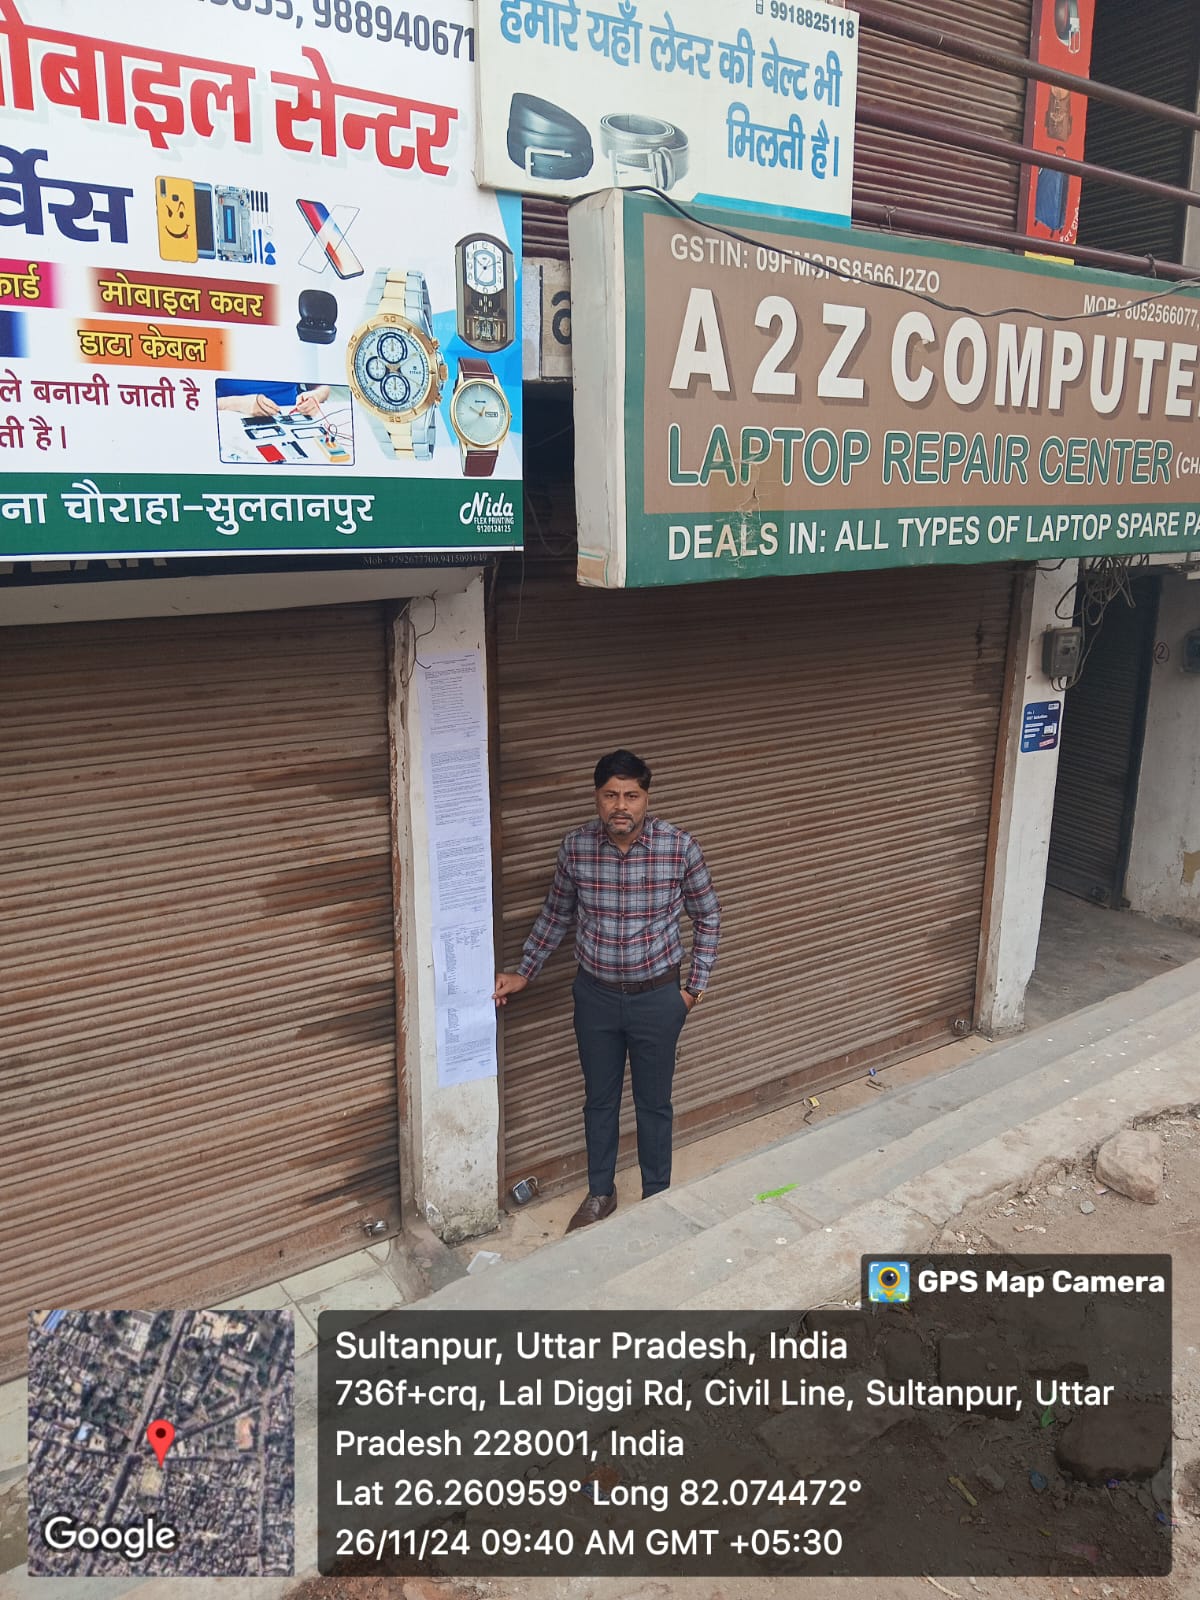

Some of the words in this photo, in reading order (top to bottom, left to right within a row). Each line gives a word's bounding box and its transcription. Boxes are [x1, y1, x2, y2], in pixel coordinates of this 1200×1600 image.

[770, 0, 855, 38] 9918825118
[650, 11, 713, 79] लेदर
[719, 28, 755, 88] की
[761, 38, 809, 100] बेल्ट
[814, 50, 843, 107] भी
[270, 45, 458, 176] सेन्टर
[726, 102, 805, 171] मिलती
[670, 233, 748, 268] GSTIN:
[99, 271, 201, 316] मोबाइल
[209, 288, 265, 318] कवर
[1083, 294, 1120, 318] MOB:
[78, 330, 132, 357] डाटा
[140, 324, 207, 362] केबल
[891, 311, 1200, 417] COMPUTE
[31, 373, 109, 406] बनायी
[118, 377, 175, 408] जाती
[180, 377, 200, 410] है
[668, 423, 871, 487] LAPTOP
[882, 430, 1030, 485] REPAIR
[1039, 435, 1174, 485] CENTER
[1176, 451, 1200, 479] (CH
[460, 492, 514, 524] Nida
[473, 517, 488, 525] FLEX
[488, 516, 514, 525] PRINTING
[668, 522, 778, 561] DEALS
[789, 521, 826, 555] IN:
[834, 519, 889, 552] ALL
[898, 515, 980, 548] TYPES
[987, 515, 1021, 544] OF
[1026, 513, 1112, 543] LAPTOP
[1116, 511, 1180, 540] SPARE
